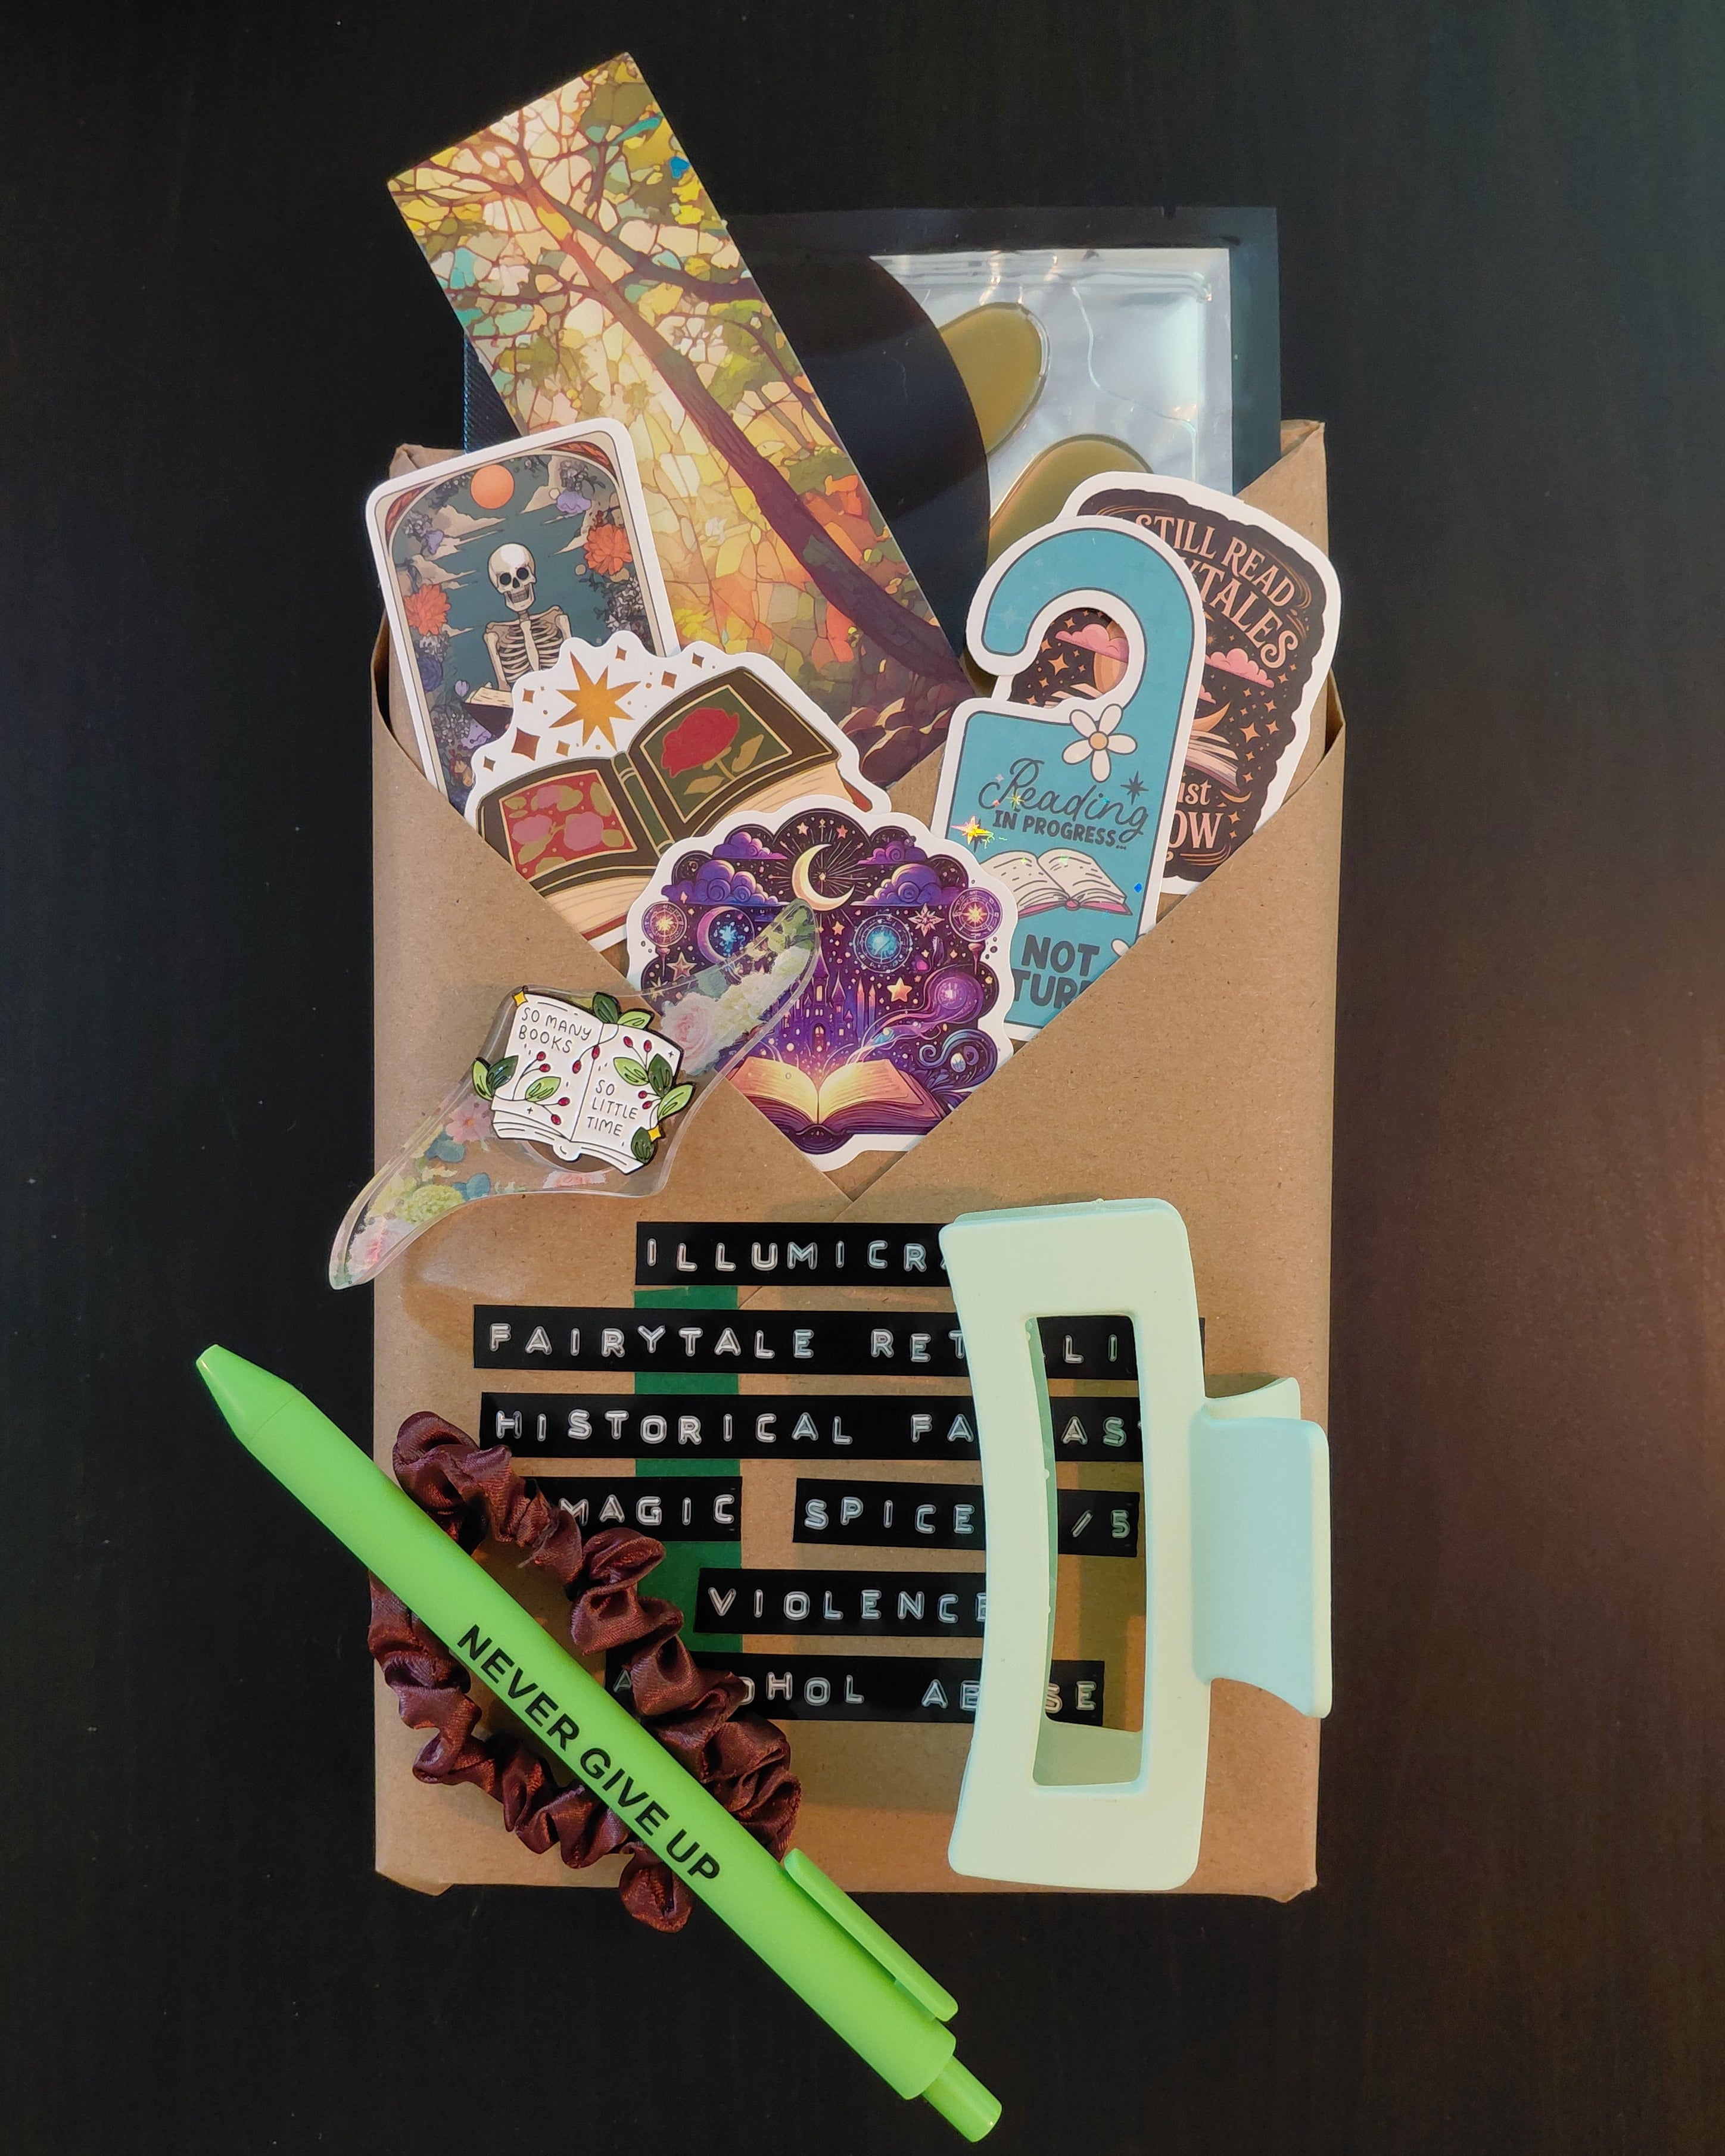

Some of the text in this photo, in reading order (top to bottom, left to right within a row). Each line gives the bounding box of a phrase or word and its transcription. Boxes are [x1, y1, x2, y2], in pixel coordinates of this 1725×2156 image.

[1221, 536, 1296, 607] READ
[979, 757, 1149, 843] Reading
[992, 809, 1127, 850] IN PROGRESS...
[1021, 934, 1100, 977] NOT
[1011, 968, 1094, 1009] TUR
[518, 1025, 573, 1054] BOOKS
[521, 1007, 592, 1041] SO MANY
[595, 1079, 615, 1096] SO
[587, 1116, 624, 1137] TIME
[591, 1097, 639, 1120] LITTLE
[647, 1238, 946, 1273] ILLUMICR
[489, 1323, 814, 1359] FAIRYTALE
[495, 1409, 853, 1445] HISTORICAL
[559, 1494, 735, 1526] MAGIC
[804, 1497, 975, 1534] SPICE
[921, 1678, 1097, 1714] ABSE
[457, 1624, 721, 1880] NEVER GIVE UP
